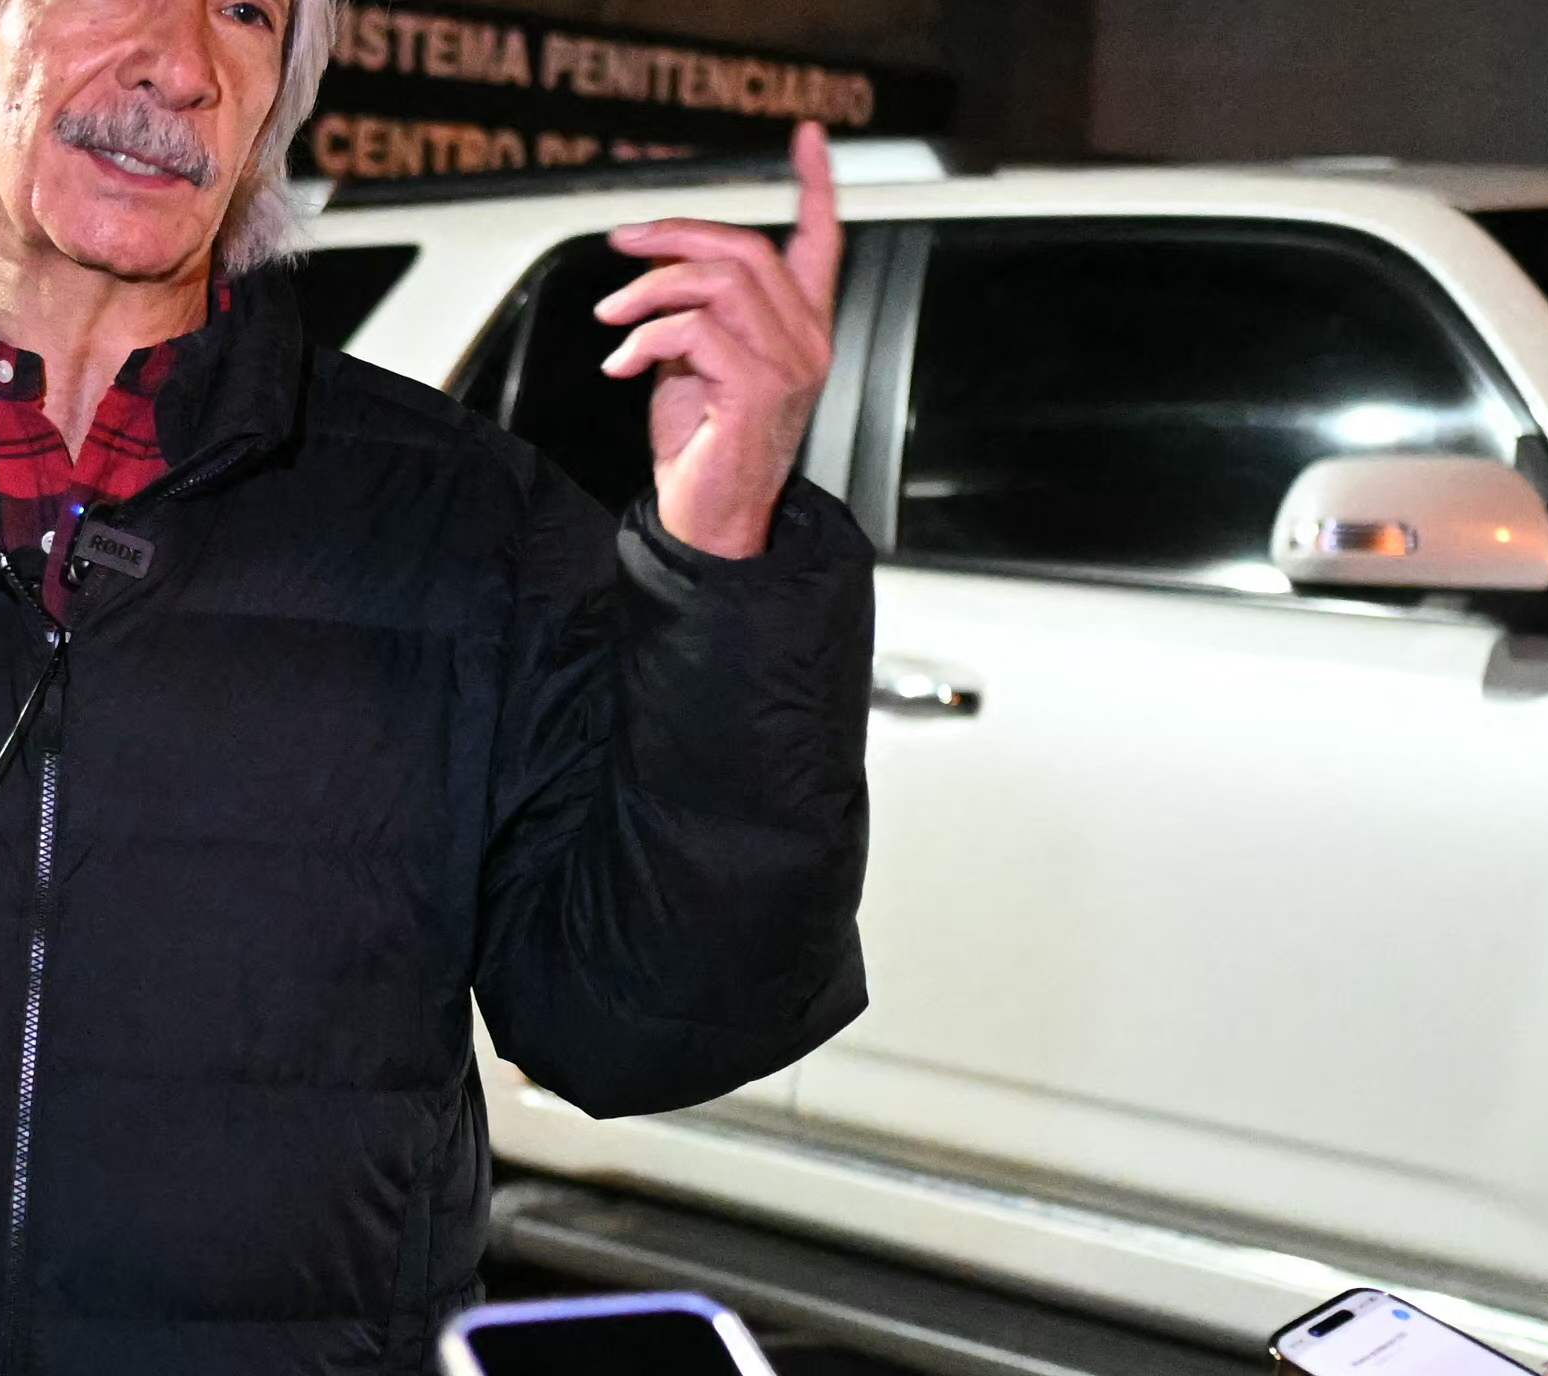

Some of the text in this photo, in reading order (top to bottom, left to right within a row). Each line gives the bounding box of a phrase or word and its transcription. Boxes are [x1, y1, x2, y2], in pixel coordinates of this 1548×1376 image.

[330, 4, 874, 127] ISTEMA PENITENCIARIO
[314, 112, 527, 180] CENTRO
